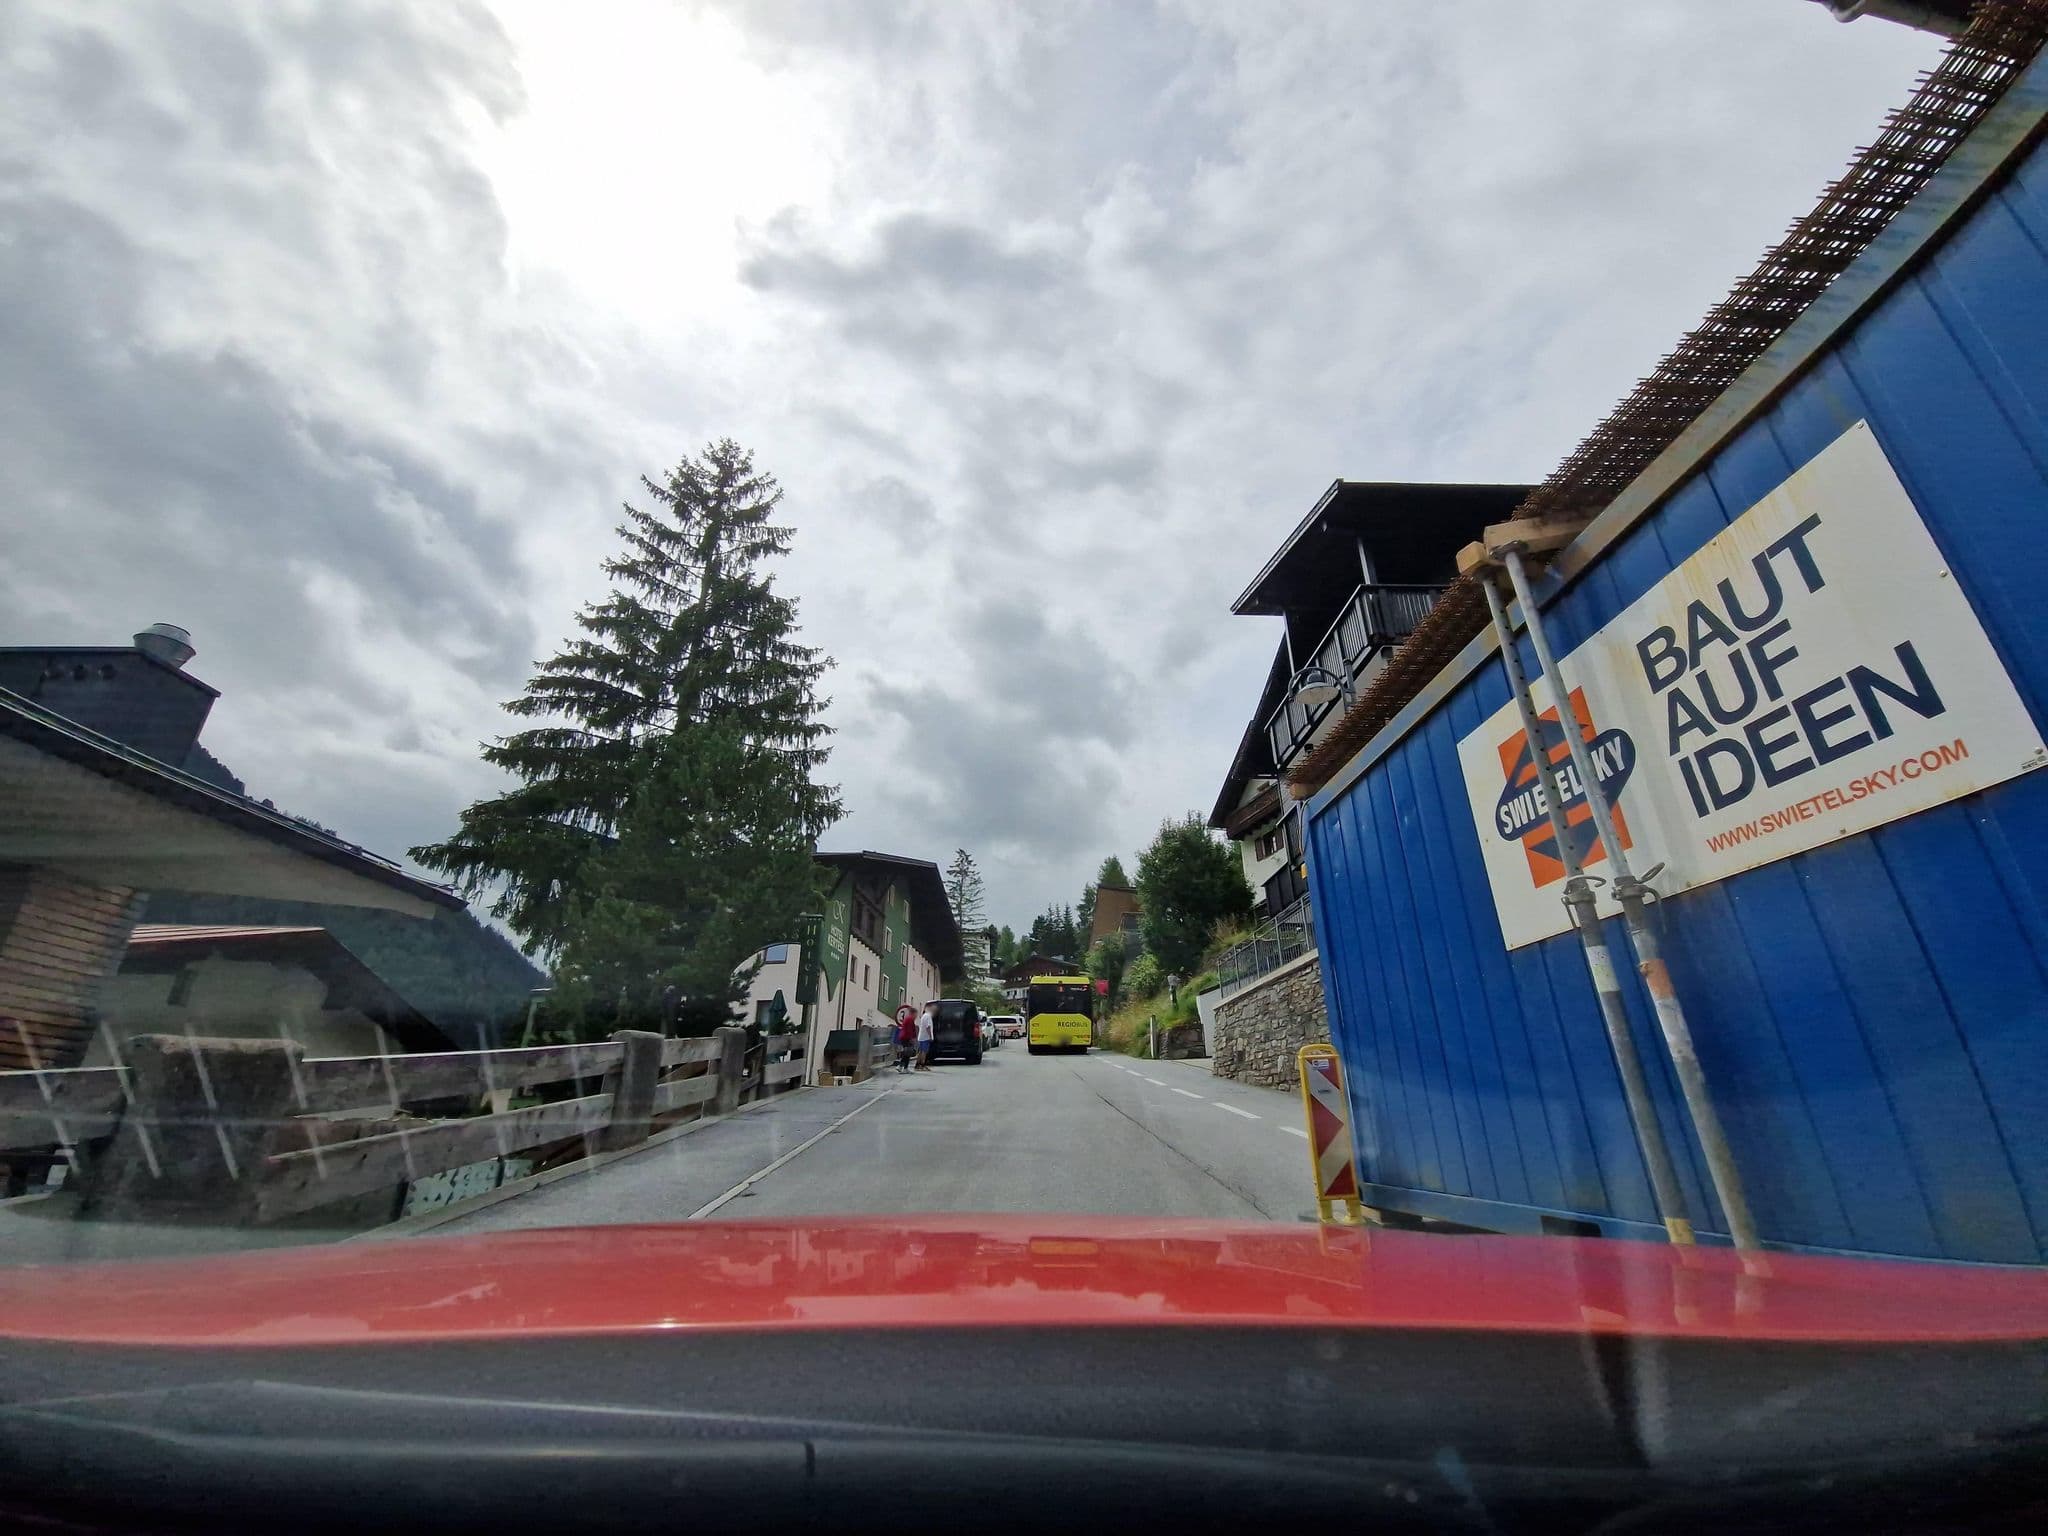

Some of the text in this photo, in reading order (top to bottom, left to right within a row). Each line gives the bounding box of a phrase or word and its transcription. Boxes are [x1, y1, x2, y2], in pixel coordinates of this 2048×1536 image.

[1636, 512, 1826, 695] BAUT
[1666, 618, 1799, 757] AUF
[1678, 639, 1947, 819] IDEEN
[1500, 735, 1625, 834] SWIEELKY
[1706, 738, 1970, 853] WWW.SWIETELSKY.COM
